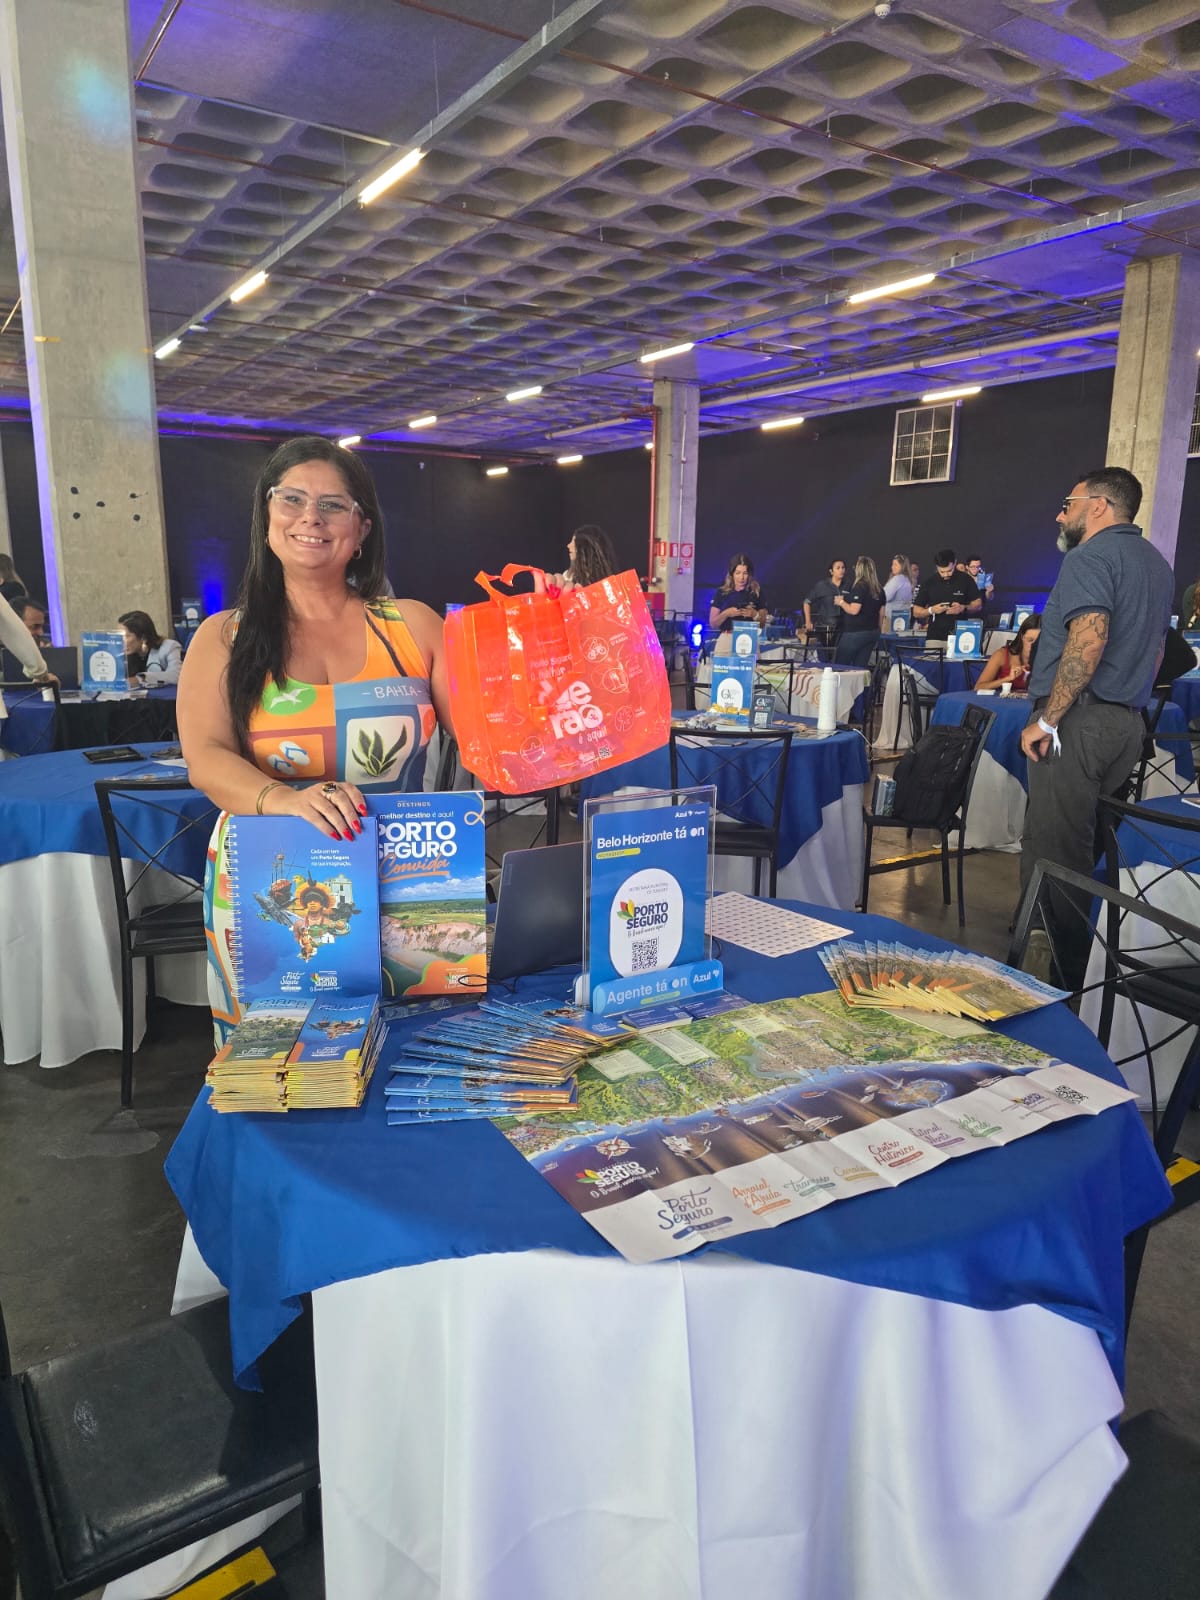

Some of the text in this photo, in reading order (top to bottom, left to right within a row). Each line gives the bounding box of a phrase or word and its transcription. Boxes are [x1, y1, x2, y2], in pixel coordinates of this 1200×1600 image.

[374, 684, 418, 699] BAHIA
[380, 812, 404, 820] melhor
[405, 811, 431, 819] destino
[437, 810, 454, 820] aqui!
[674, 811, 688, 819] Azul
[597, 825, 705, 849] Belo Horizonte tá on
[380, 853, 450, 880] Convida
[633, 902, 669, 918] PORTO
[626, 913, 669, 930] SEGURO
[607, 984, 653, 1004] Agente
[656, 979, 668, 993] tá
[671, 977, 688, 989] on
[693, 971, 711, 984] Azul
[868, 1140, 900, 1155] Centro
[594, 1165, 646, 1188] SEGURO
[597, 1161, 639, 1179] PORTO
[731, 1178, 770, 1199] Arraial
[663, 1187, 711, 1213] Porto
[657, 1206, 714, 1230] Seguro
